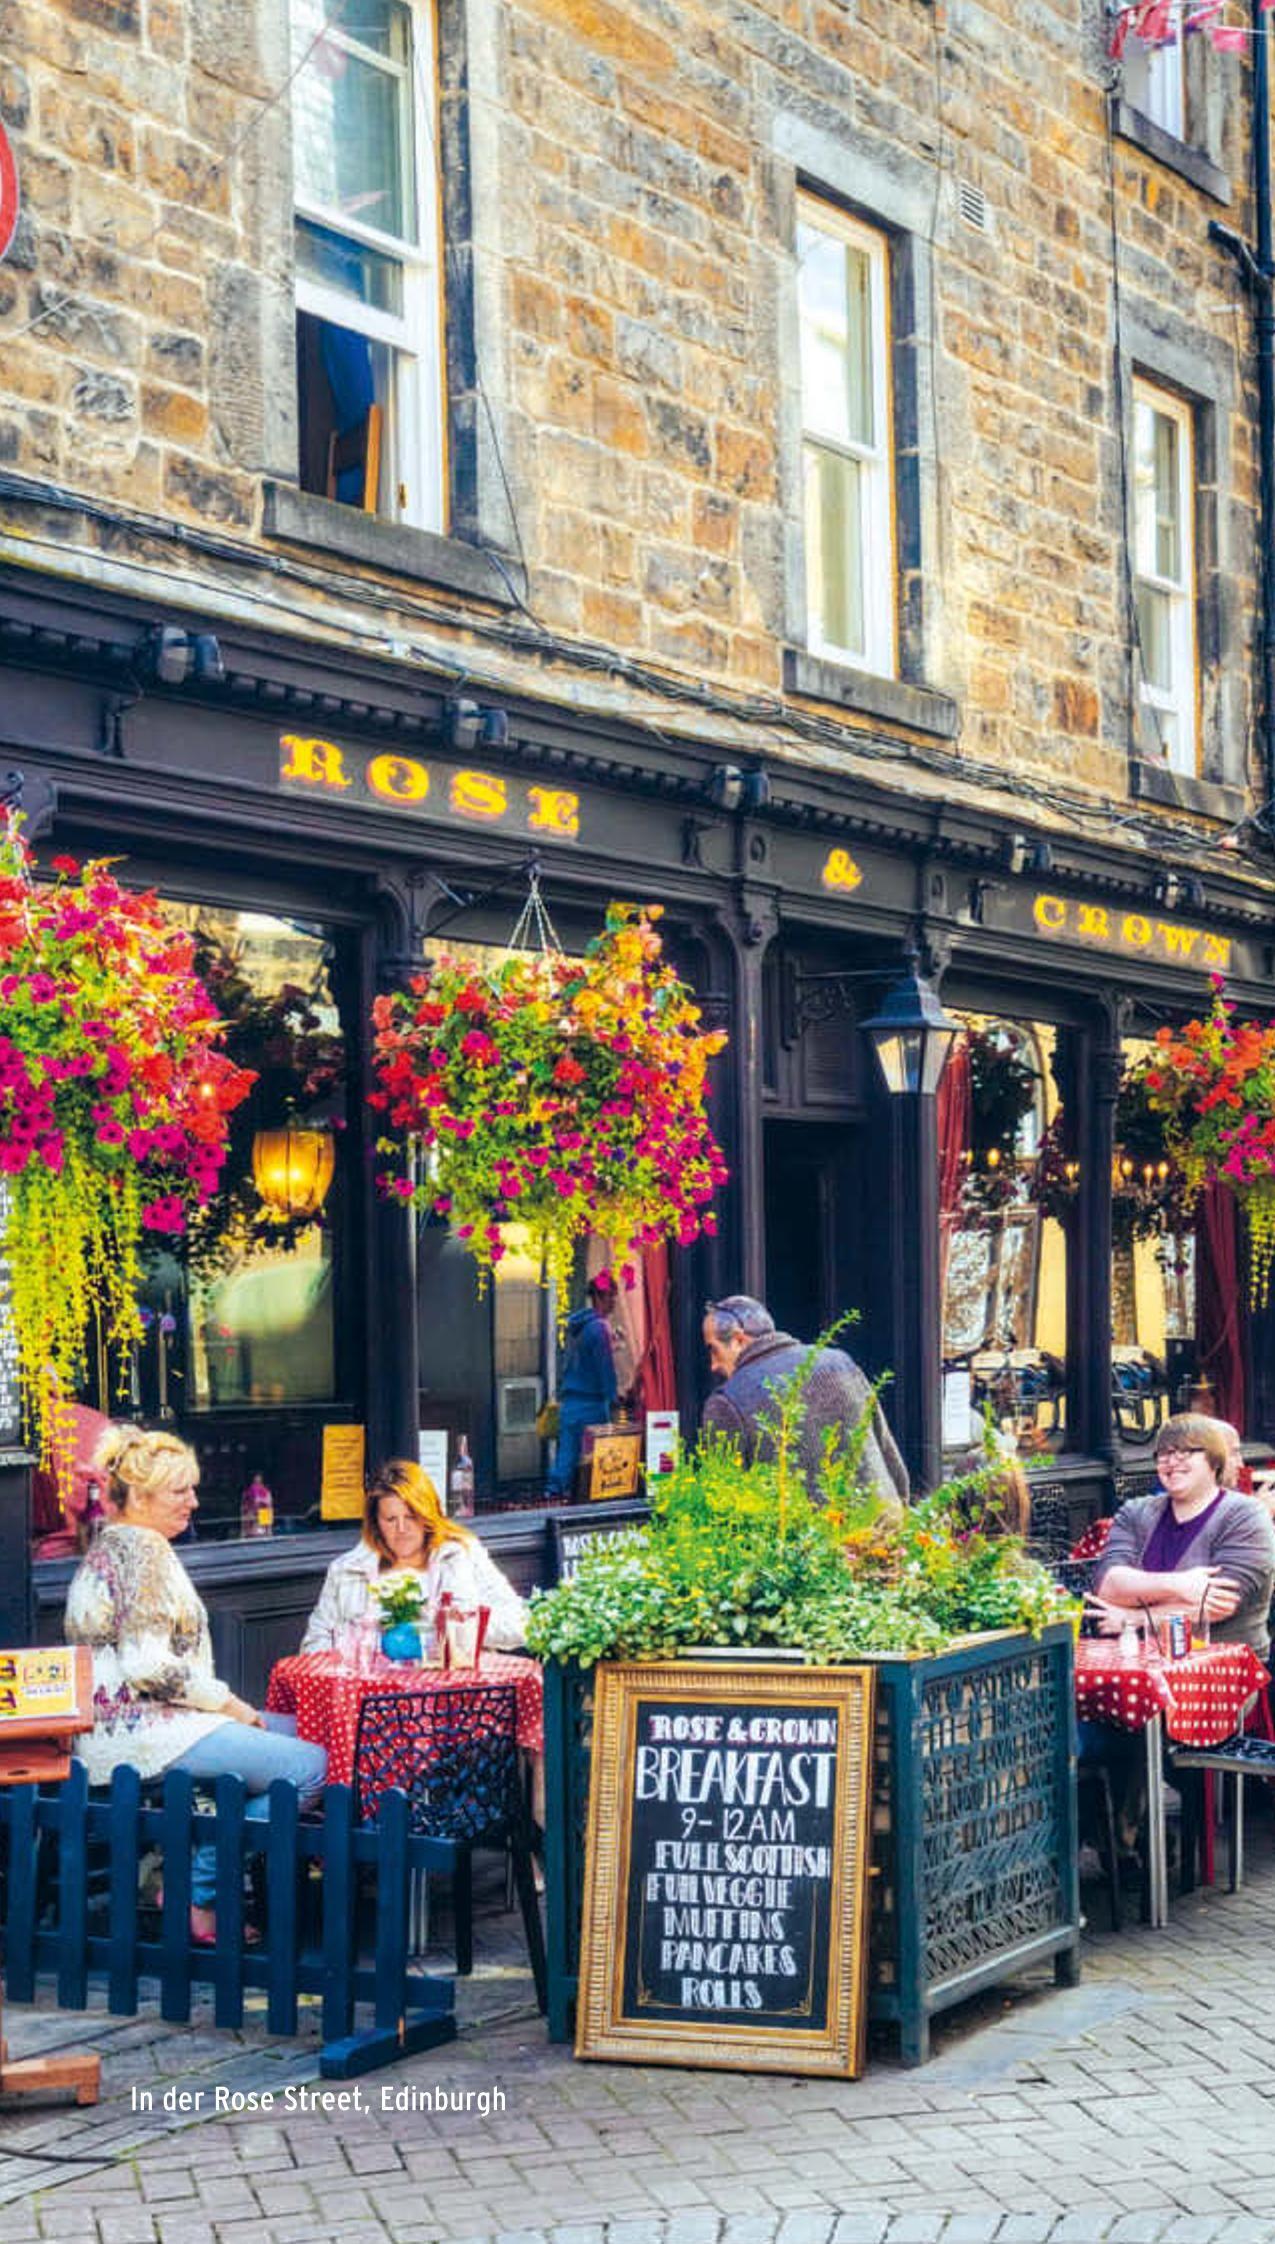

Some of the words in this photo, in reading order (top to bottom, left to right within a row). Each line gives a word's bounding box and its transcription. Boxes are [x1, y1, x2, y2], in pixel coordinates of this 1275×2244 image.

[279, 734, 580, 837] ROSE
[822, 848, 863, 891] &
[1032, 894, 1232, 965] CROWN
[649, 1714, 724, 1741] ROSE
[635, 1745, 838, 1808] BREAKFAST
[655, 1841, 720, 1872] FULL
[723, 1843, 831, 1877] SCOTTISH
[646, 1873, 699, 1903] FULL
[702, 1875, 795, 1909] VEGGIE
[663, 1906, 786, 1941] MUFFINS
[660, 1939, 797, 1976] PANCAKES
[680, 1977, 763, 2009] ROLLS
